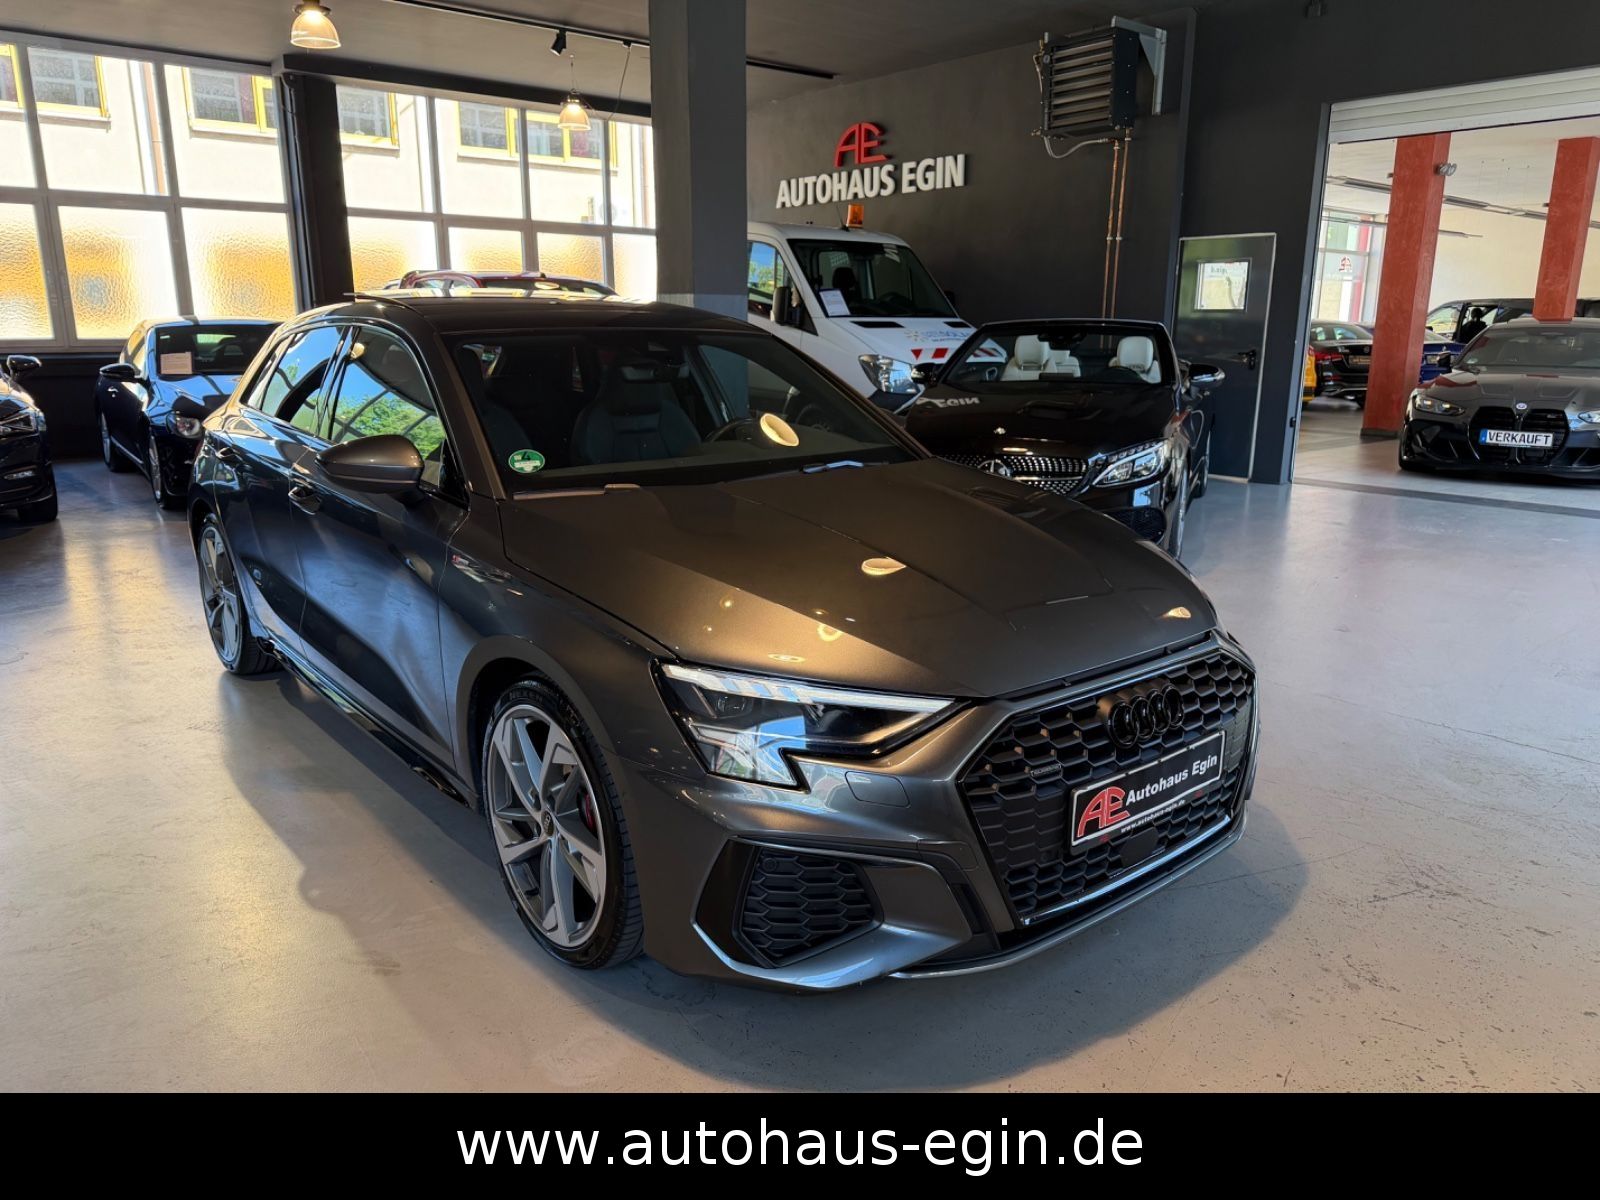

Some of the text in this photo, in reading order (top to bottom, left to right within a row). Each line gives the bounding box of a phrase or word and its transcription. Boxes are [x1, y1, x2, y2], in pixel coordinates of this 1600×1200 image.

[776, 154, 966, 209] AUTOHAUS EGIN
[1488, 431, 1551, 445] VERKAUFT
[1125, 769, 1189, 807] Autohaus
[1191, 755, 1218, 776] Egin
